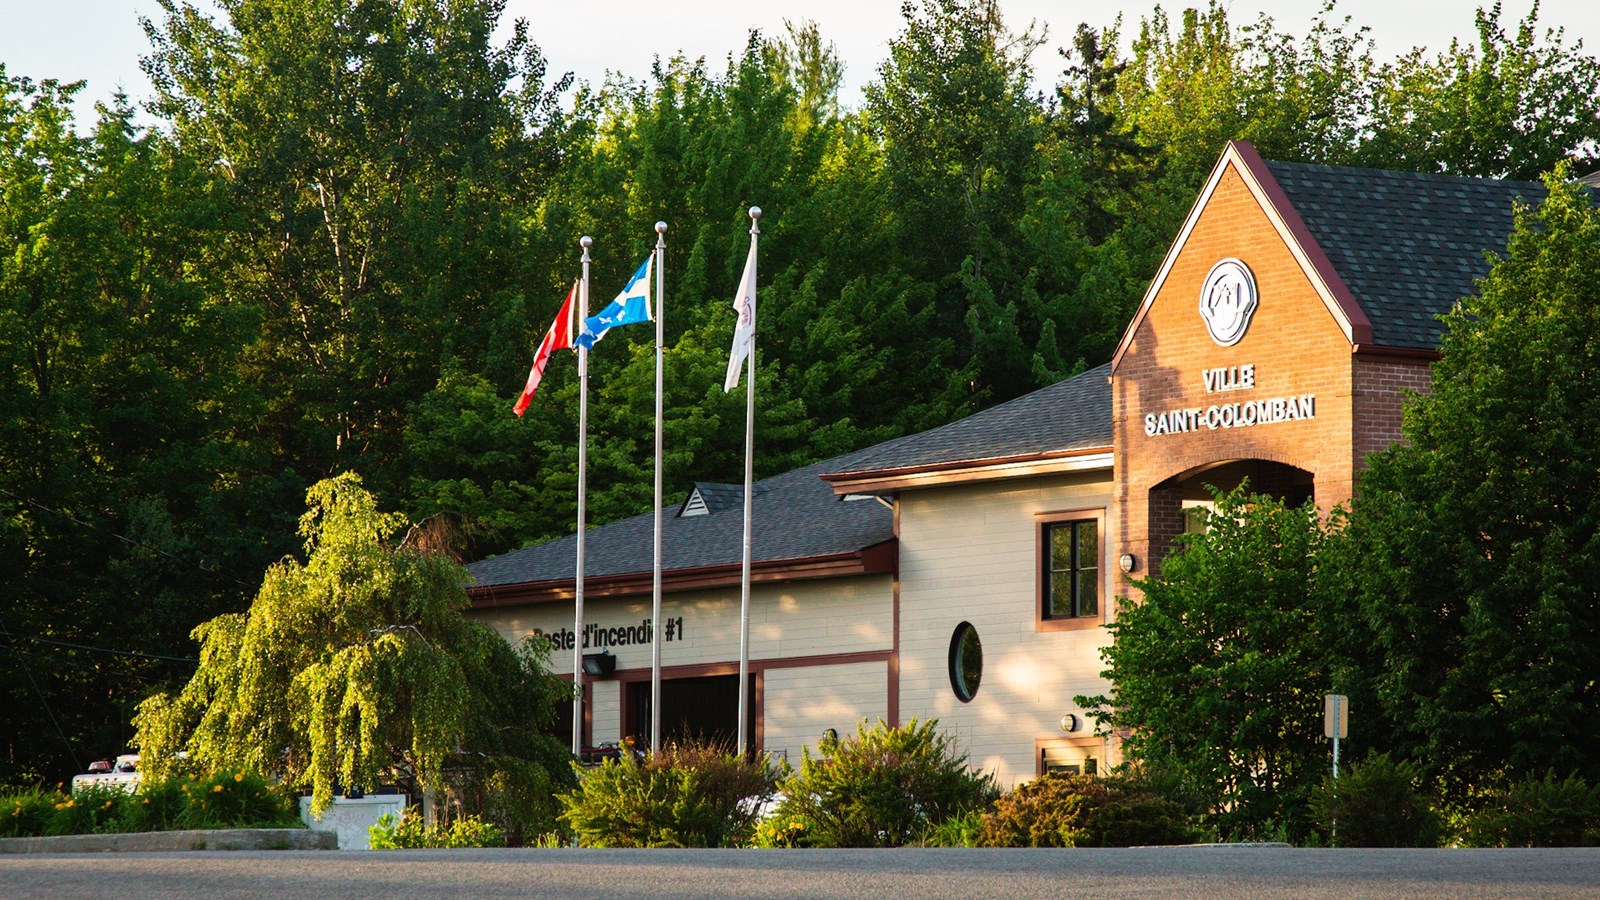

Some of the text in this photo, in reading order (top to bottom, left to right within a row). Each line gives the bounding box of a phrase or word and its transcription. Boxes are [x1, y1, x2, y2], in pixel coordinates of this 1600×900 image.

[1202, 364, 1255, 393] VILLE
[1144, 394, 1316, 437] SAINT-COLOMBAN
[582, 618, 654, 649] d'incendi
[665, 616, 683, 642] #1
